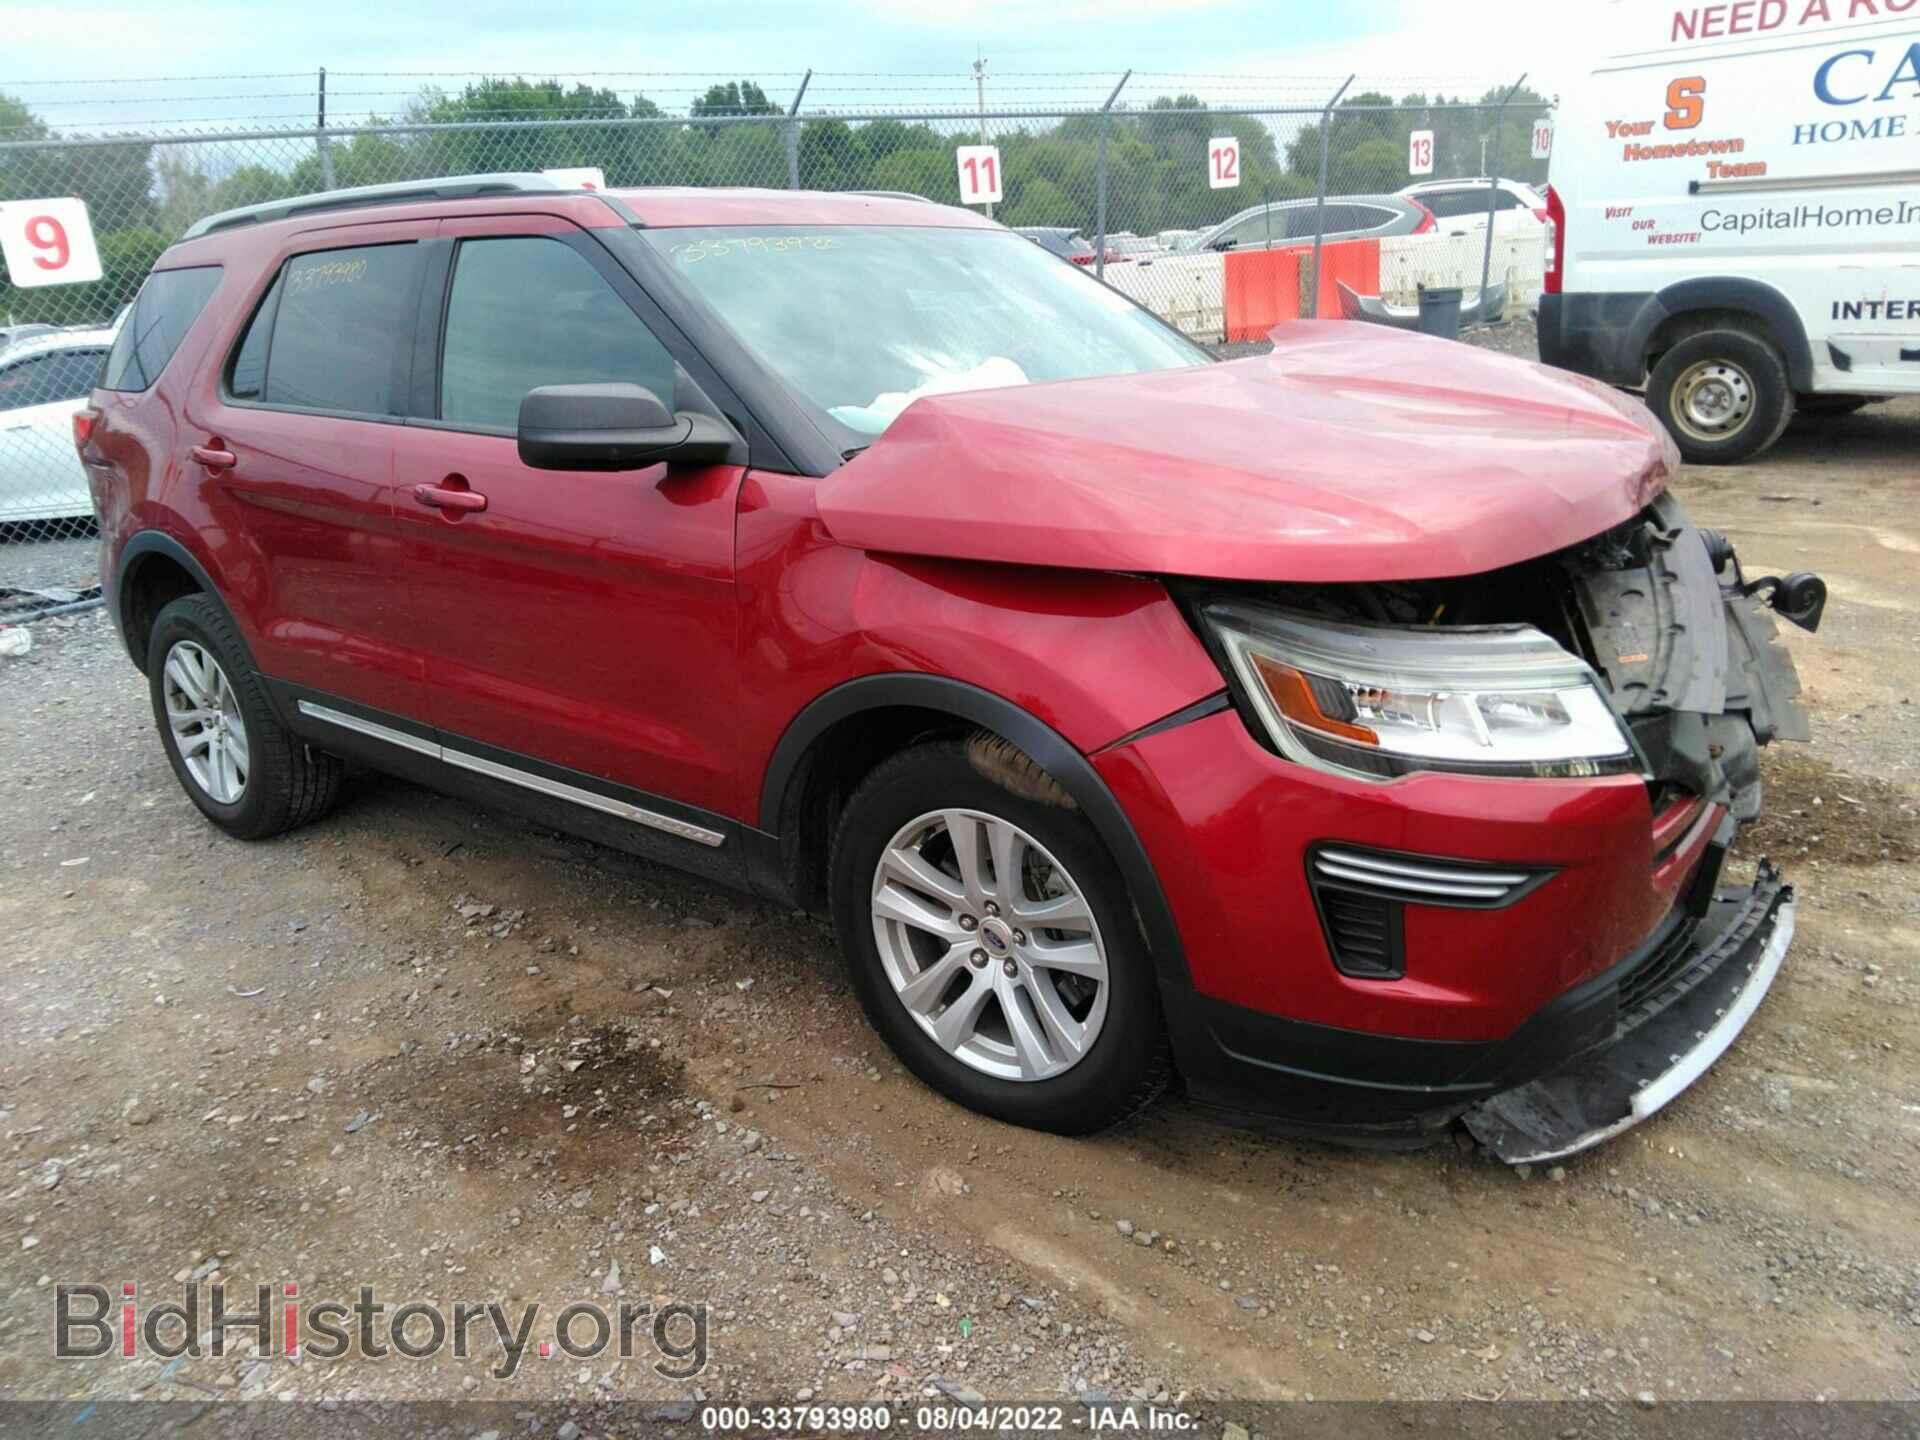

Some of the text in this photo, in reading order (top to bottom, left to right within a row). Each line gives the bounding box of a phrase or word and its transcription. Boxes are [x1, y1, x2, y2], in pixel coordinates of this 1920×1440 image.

[1671, 0, 1787, 42] NEED
[1798, 0, 1831, 25] A
[1813, 41, 1920, 105] CA
[1663, 75, 1706, 130] S
[1536, 128, 1549, 150] 10
[1605, 120, 1656, 138] Your
[1793, 115, 1906, 145] HOME
[1211, 147, 1237, 180] 12
[1413, 139, 1431, 167] 13
[1623, 137, 1744, 161] Hometown
[963, 157, 996, 193] 11
[1706, 160, 1767, 179] Team
[25, 215, 71, 270] 9
